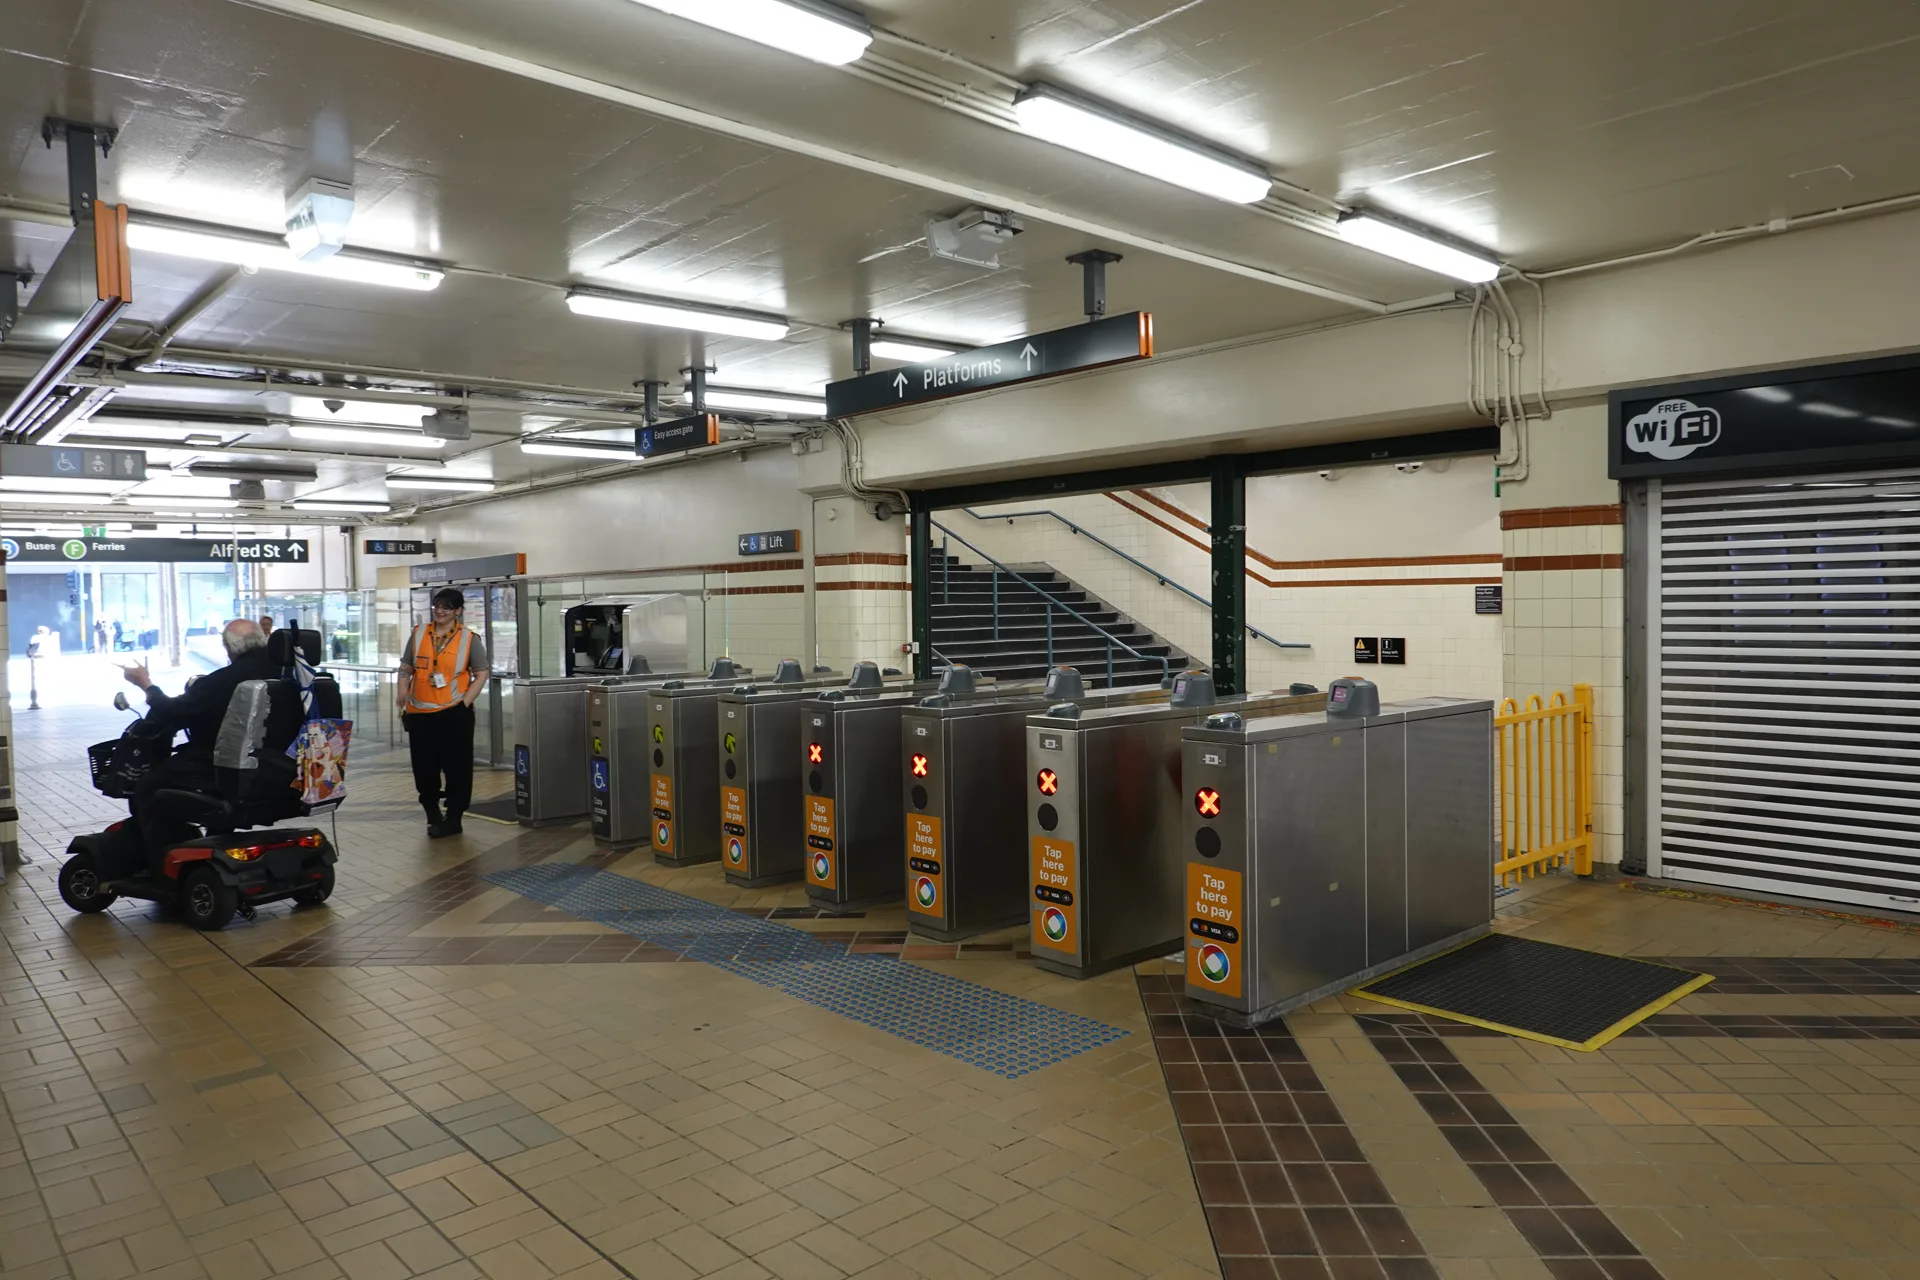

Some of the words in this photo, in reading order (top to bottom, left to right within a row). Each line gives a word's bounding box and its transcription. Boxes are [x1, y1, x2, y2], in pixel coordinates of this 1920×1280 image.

[924, 358, 1002, 390] Platforms
[1658, 402, 1687, 413] FREE
[654, 431, 665, 440] Easy
[666, 428, 682, 437] access
[682, 425, 694, 436] gate
[399, 543, 416, 552] Lift
[769, 536, 783, 548] Lift
[25, 542, 56, 551] Buses
[92, 542, 126, 551] Ferries
[263, 544, 281, 558] St
[658, 780, 667, 790] Tap
[656, 788, 668, 798] here
[728, 792, 738, 802] Tap
[660, 800, 669, 808] pay
[728, 801, 740, 812] here
[814, 802, 826, 814] Tap
[732, 814, 742, 822] pay
[812, 812, 828, 823] here
[810, 822, 818, 831] to
[818, 825, 830, 835] pay
[917, 821, 931, 834] Tap
[916, 832, 933, 844] here
[913, 843, 921, 852] to
[922, 846, 936, 858] pay
[1044, 845, 1062, 860] Tap
[1042, 857, 1064, 871] here
[1040, 870, 1050, 880] to
[1051, 874, 1068, 886] pay
[1203, 874, 1226, 891] Tap
[1200, 886, 1228, 904] here
[1196, 900, 1208, 914] to
[1211, 906, 1232, 920] pay
